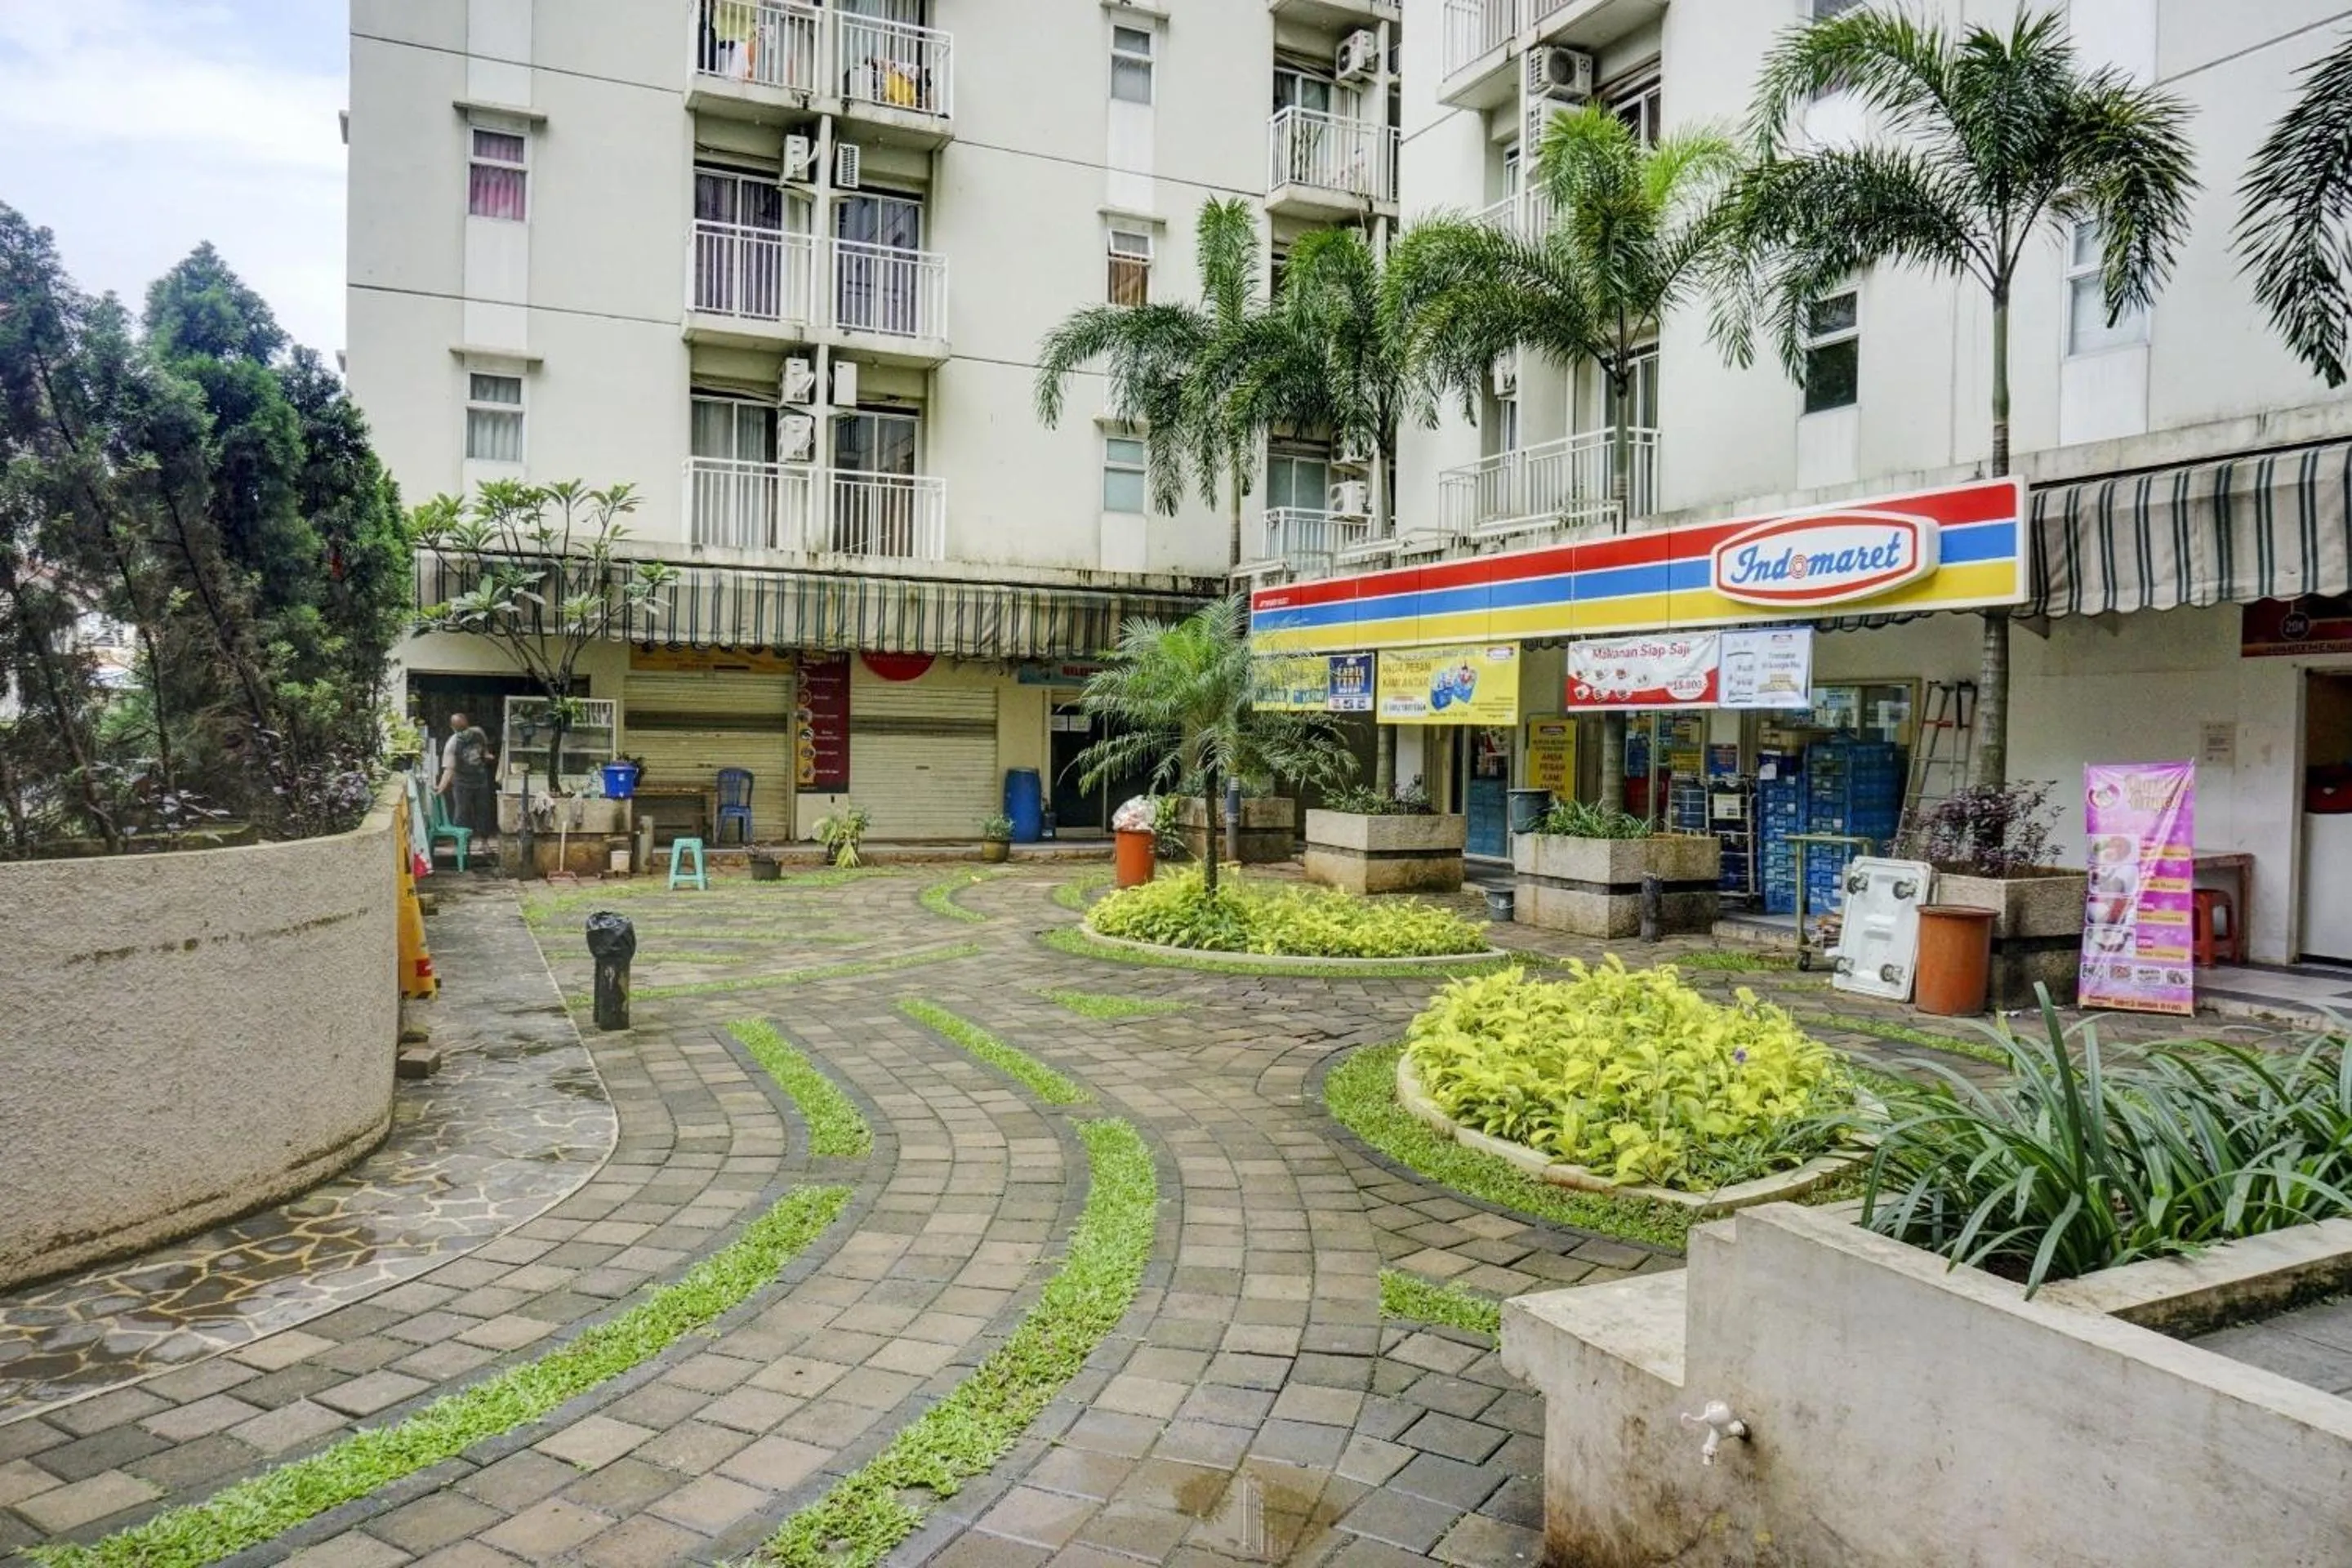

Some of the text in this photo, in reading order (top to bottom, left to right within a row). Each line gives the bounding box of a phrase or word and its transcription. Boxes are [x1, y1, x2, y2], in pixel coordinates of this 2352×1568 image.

[1731, 531, 1901, 584] Indomaret
[1592, 642, 1690, 660] Makanan Siap Saji
[1405, 662, 1432, 672] PESAN
